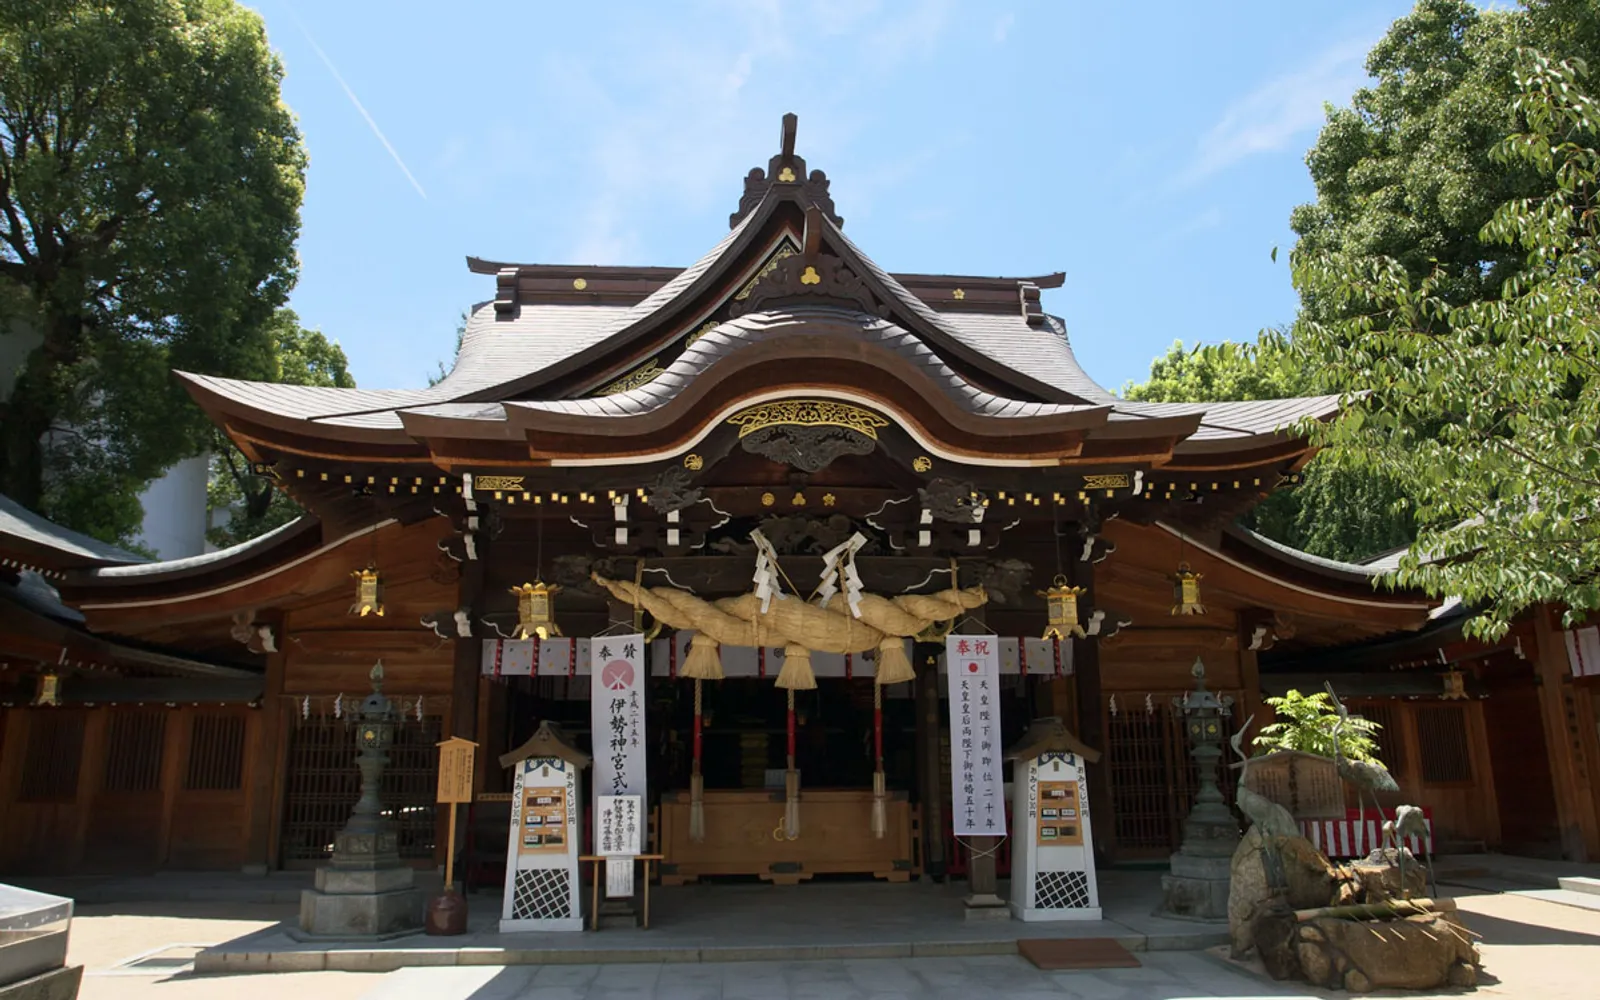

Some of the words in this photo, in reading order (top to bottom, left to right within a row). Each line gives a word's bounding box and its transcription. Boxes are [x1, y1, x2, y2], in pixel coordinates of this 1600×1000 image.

[599, 643, 638, 661] 奉賛
[956, 639, 990, 656] 奉祝
[629, 691, 640, 747] 平成二十五年
[961, 680, 976, 829] 天皇皇后両陛下御結婚五十年
[980, 680, 995, 829] 天皇陛下御即位二十年
